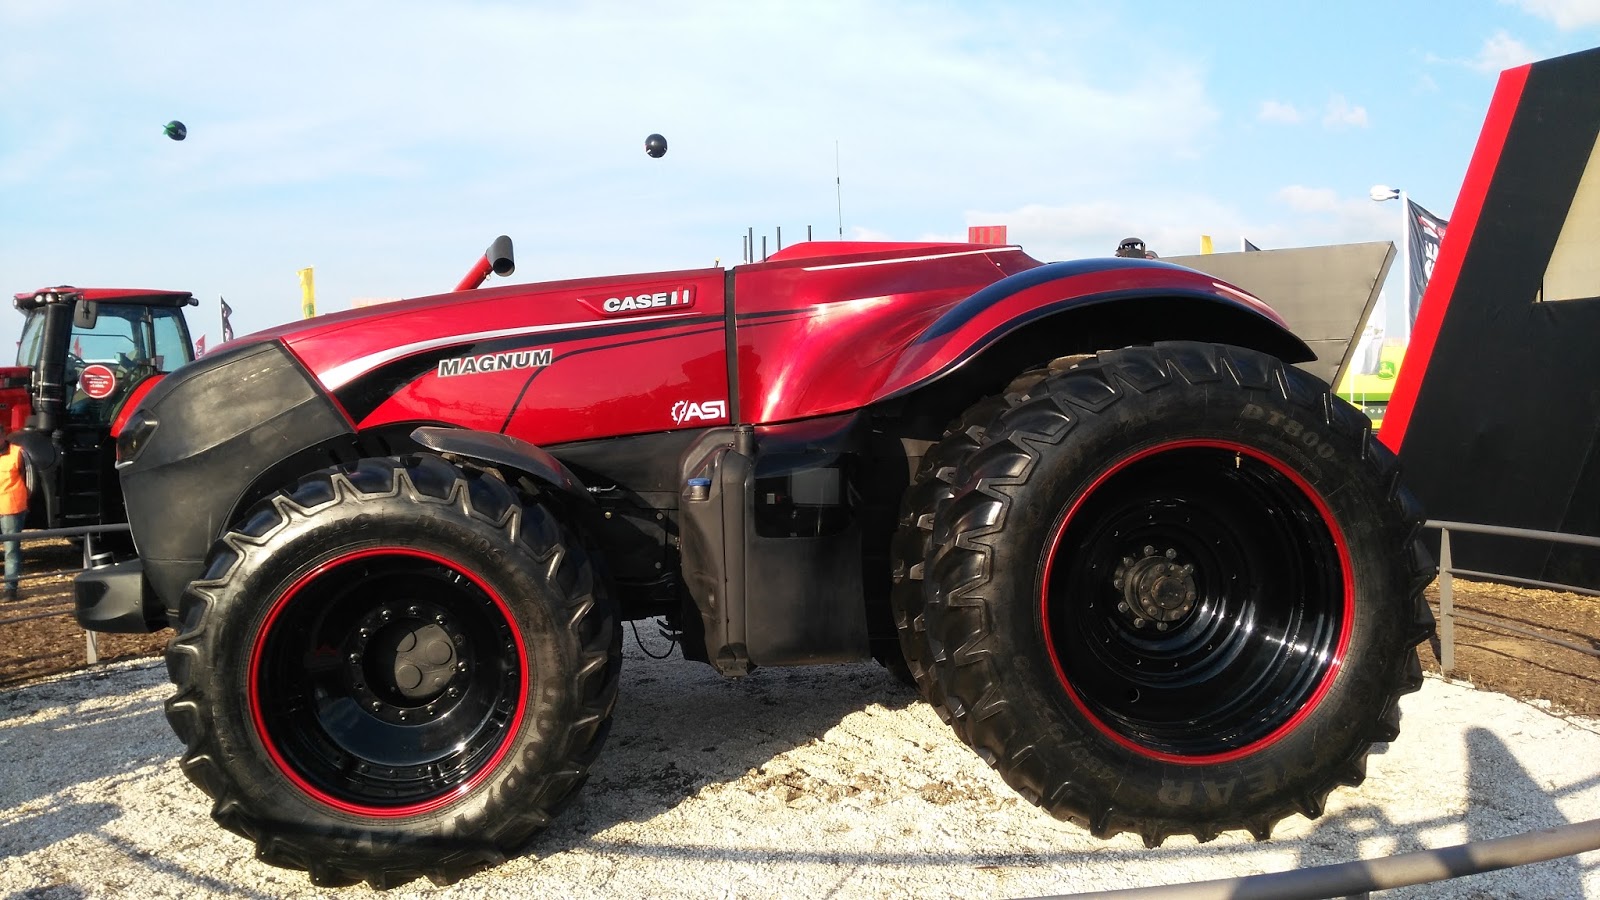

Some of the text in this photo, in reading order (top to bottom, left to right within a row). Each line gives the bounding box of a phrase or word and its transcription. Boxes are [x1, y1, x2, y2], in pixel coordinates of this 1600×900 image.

[603, 293, 667, 312] CASE
[438, 349, 553, 378] MAGNUM
[684, 400, 726, 421] ASI
